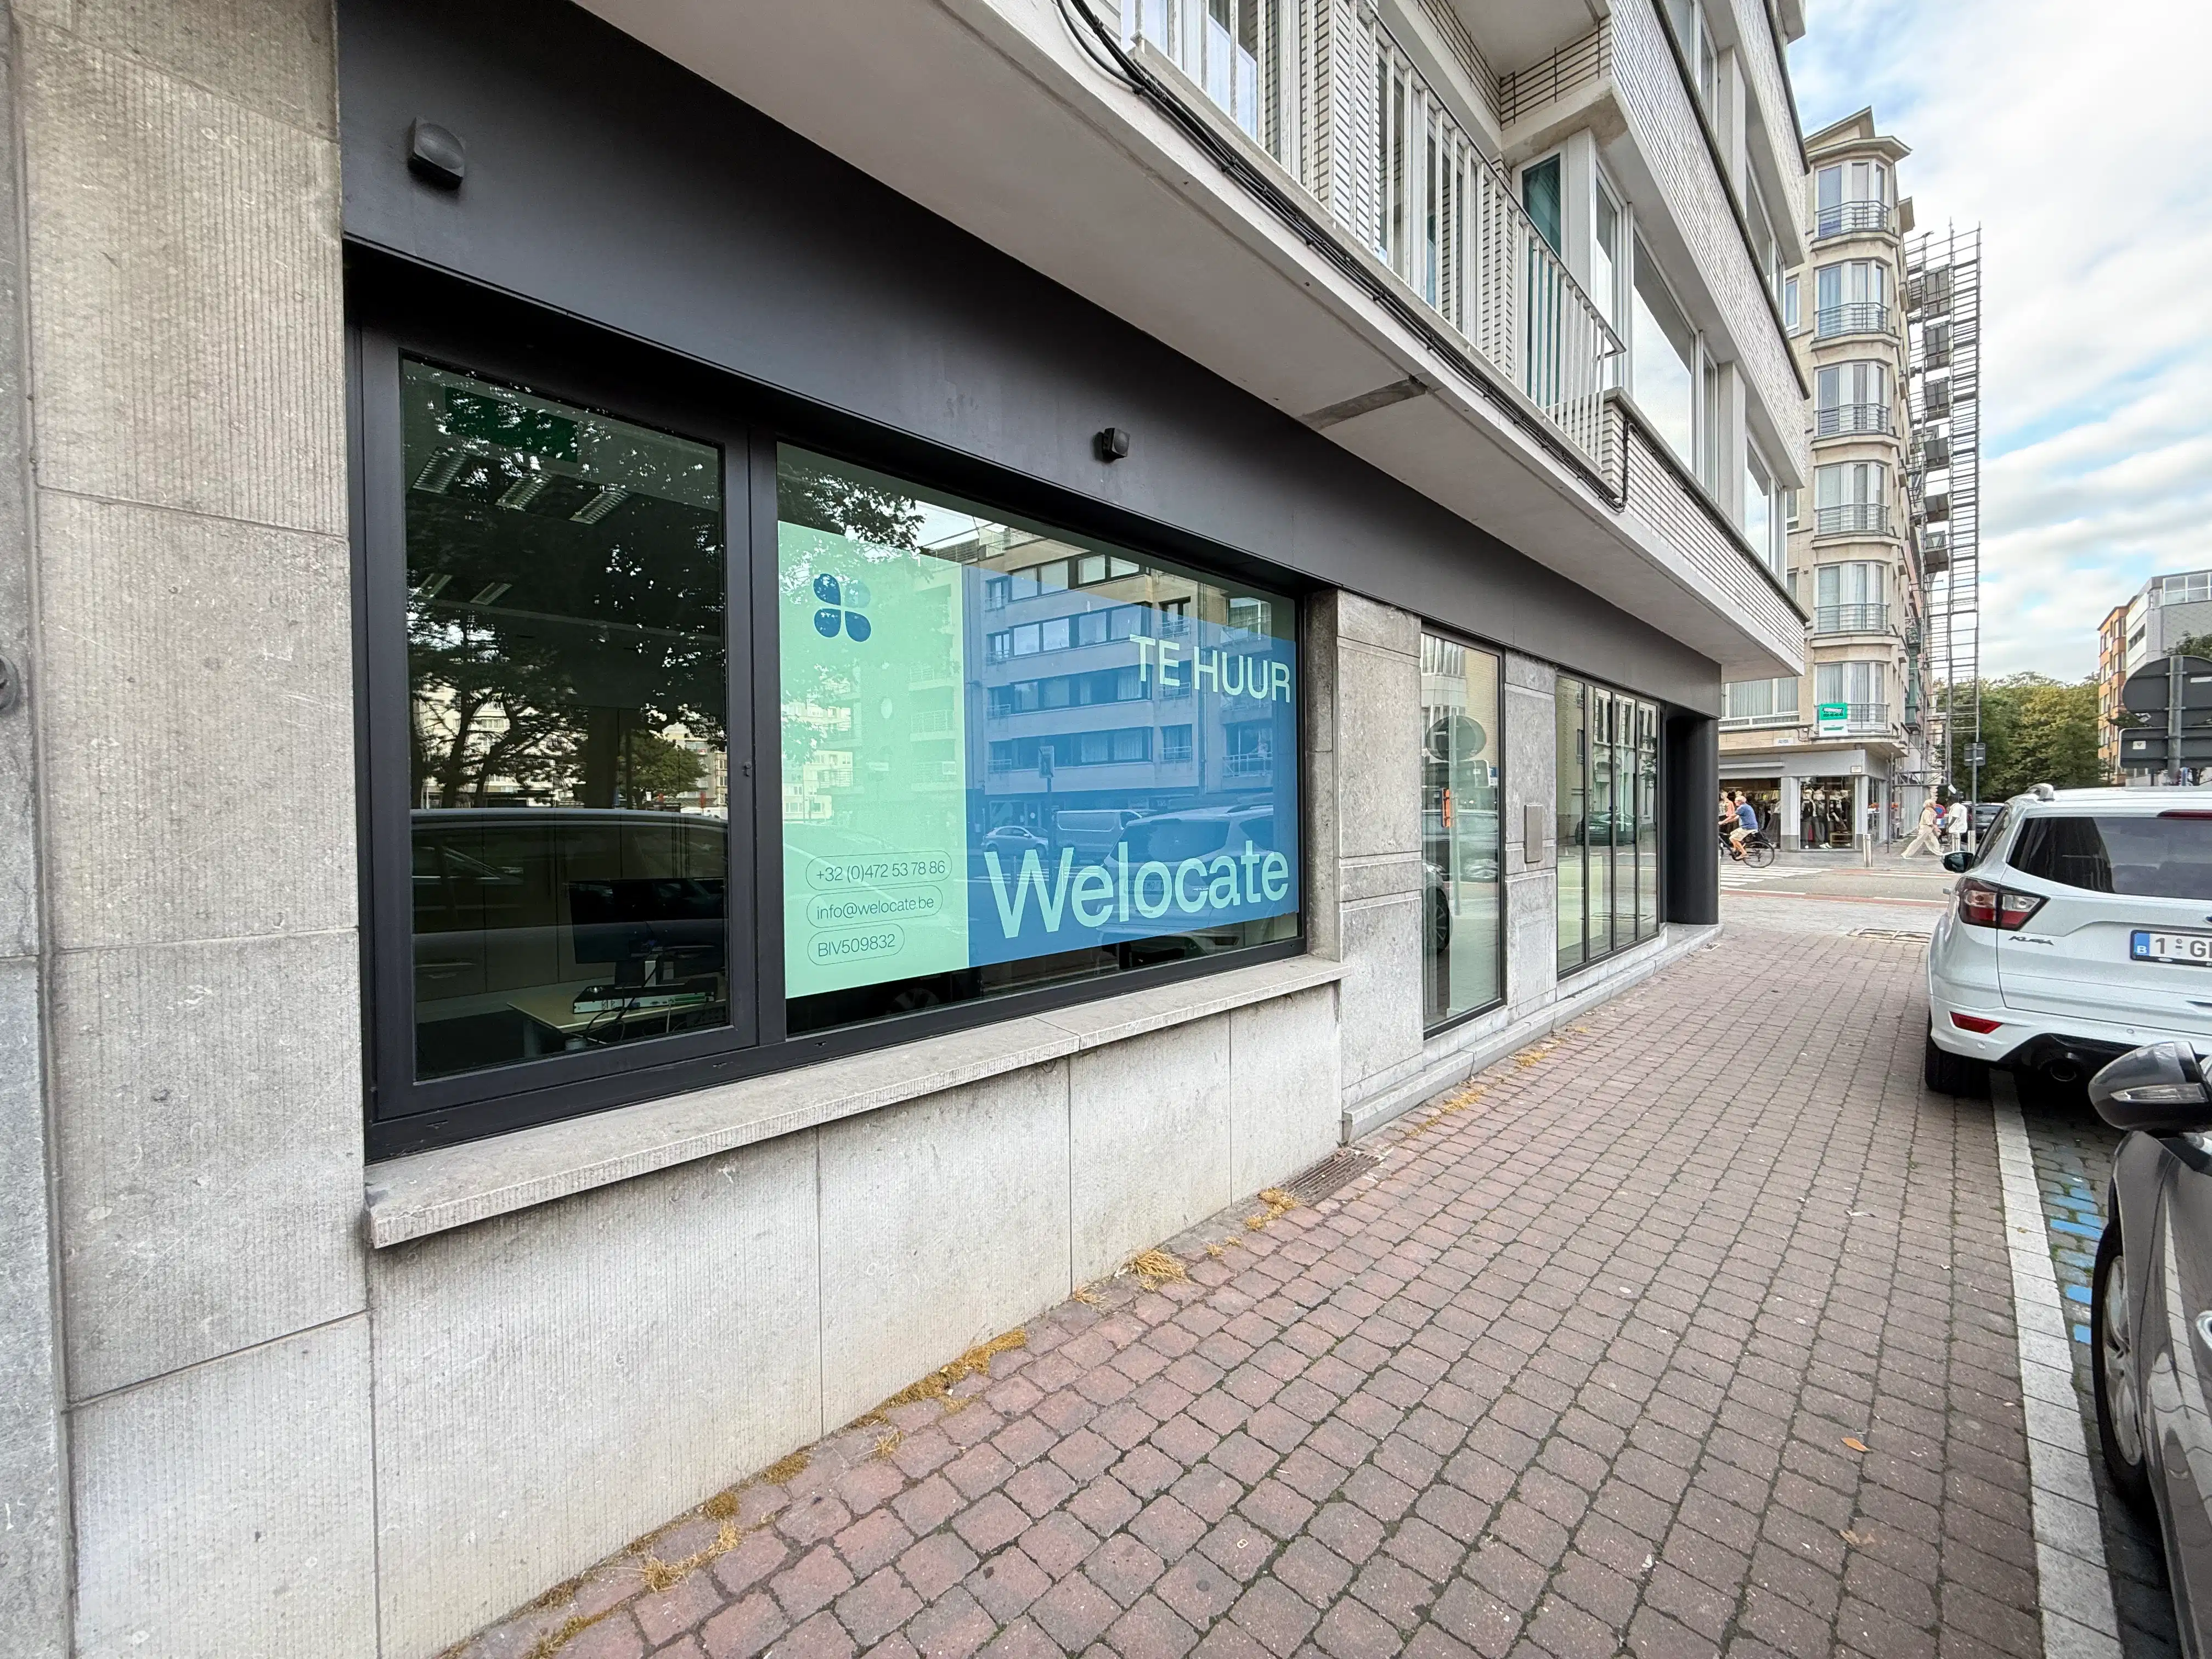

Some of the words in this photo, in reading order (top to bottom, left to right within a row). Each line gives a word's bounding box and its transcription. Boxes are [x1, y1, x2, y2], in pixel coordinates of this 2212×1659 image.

[1129, 634, 1180, 687] TE
[1193, 646, 1290, 703] HUUR
[816, 866, 843, 882] +32
[847, 864, 889, 883] (0)472
[892, 862, 909, 877] 53
[911, 861, 926, 876] 78
[929, 860, 945, 874] 86
[984, 839, 1289, 939] Welocate
[816, 896, 934, 920] info@welocate.be
[817, 934, 896, 957] BIV509832
[2136, 945, 2147, 953] B
